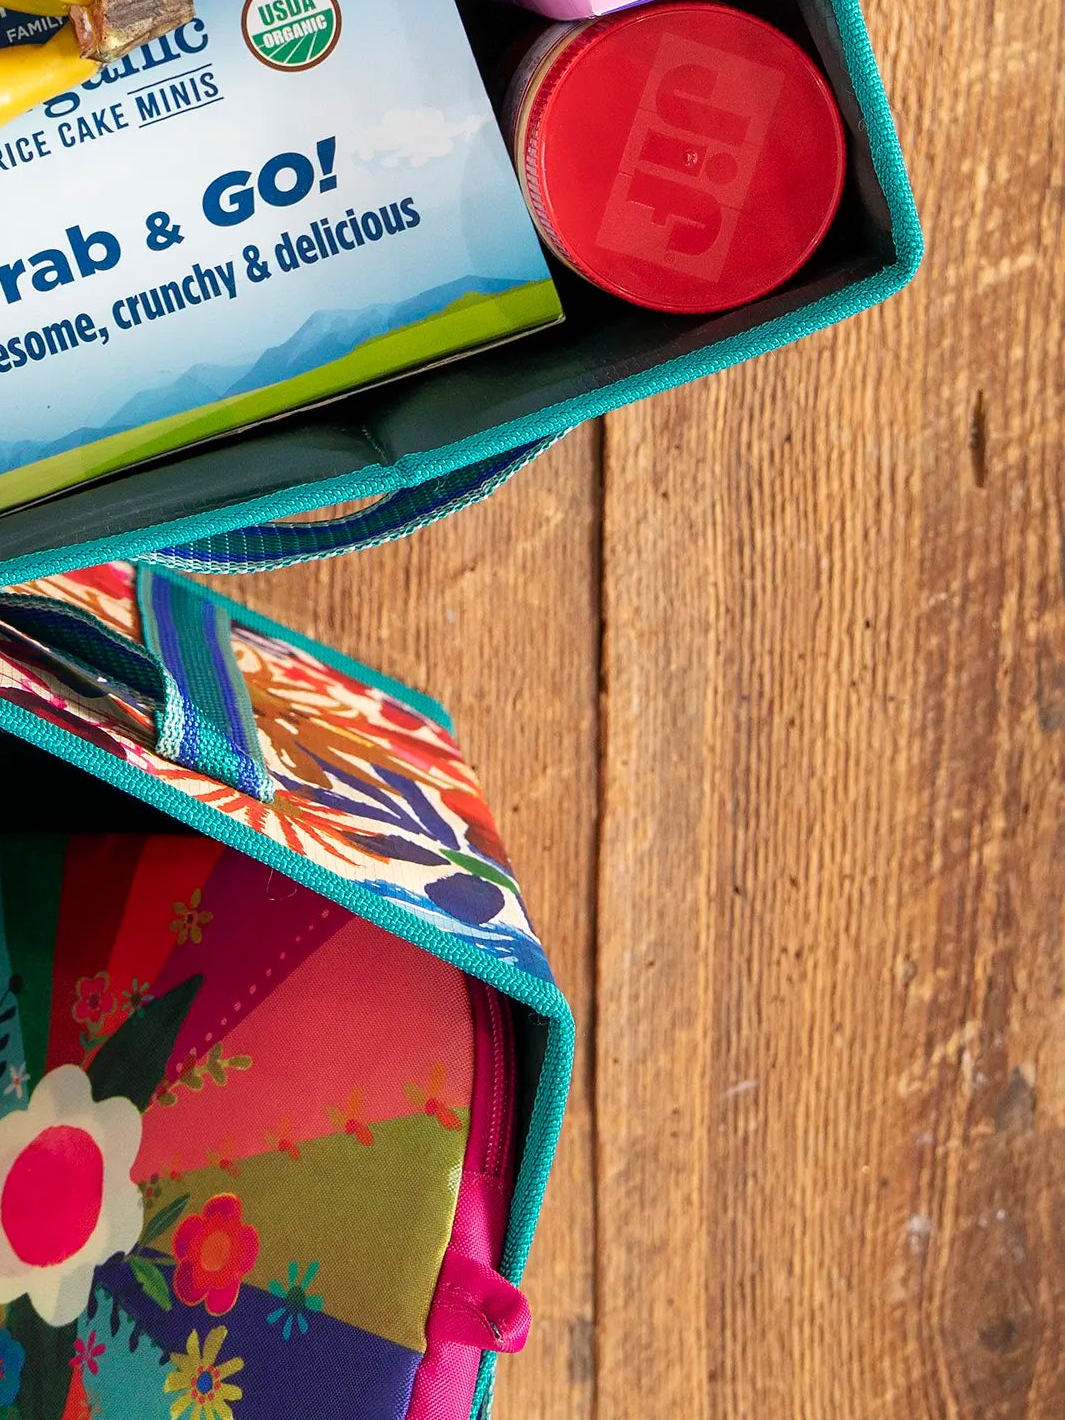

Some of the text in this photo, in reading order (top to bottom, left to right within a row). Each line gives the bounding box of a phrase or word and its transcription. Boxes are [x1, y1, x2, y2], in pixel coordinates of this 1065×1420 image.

[261, 15, 329, 49] ORGANIC
[57, 103, 129, 149] CAKE
[134, 71, 220, 122] MINIS
[625, 64, 753, 256] Jif
[144, 210, 186, 252] &
[202, 136, 338, 228] GO!
[111, 258, 237, 332] crunchy
[246, 244, 273, 284] &
[274, 196, 423, 272] delicious
